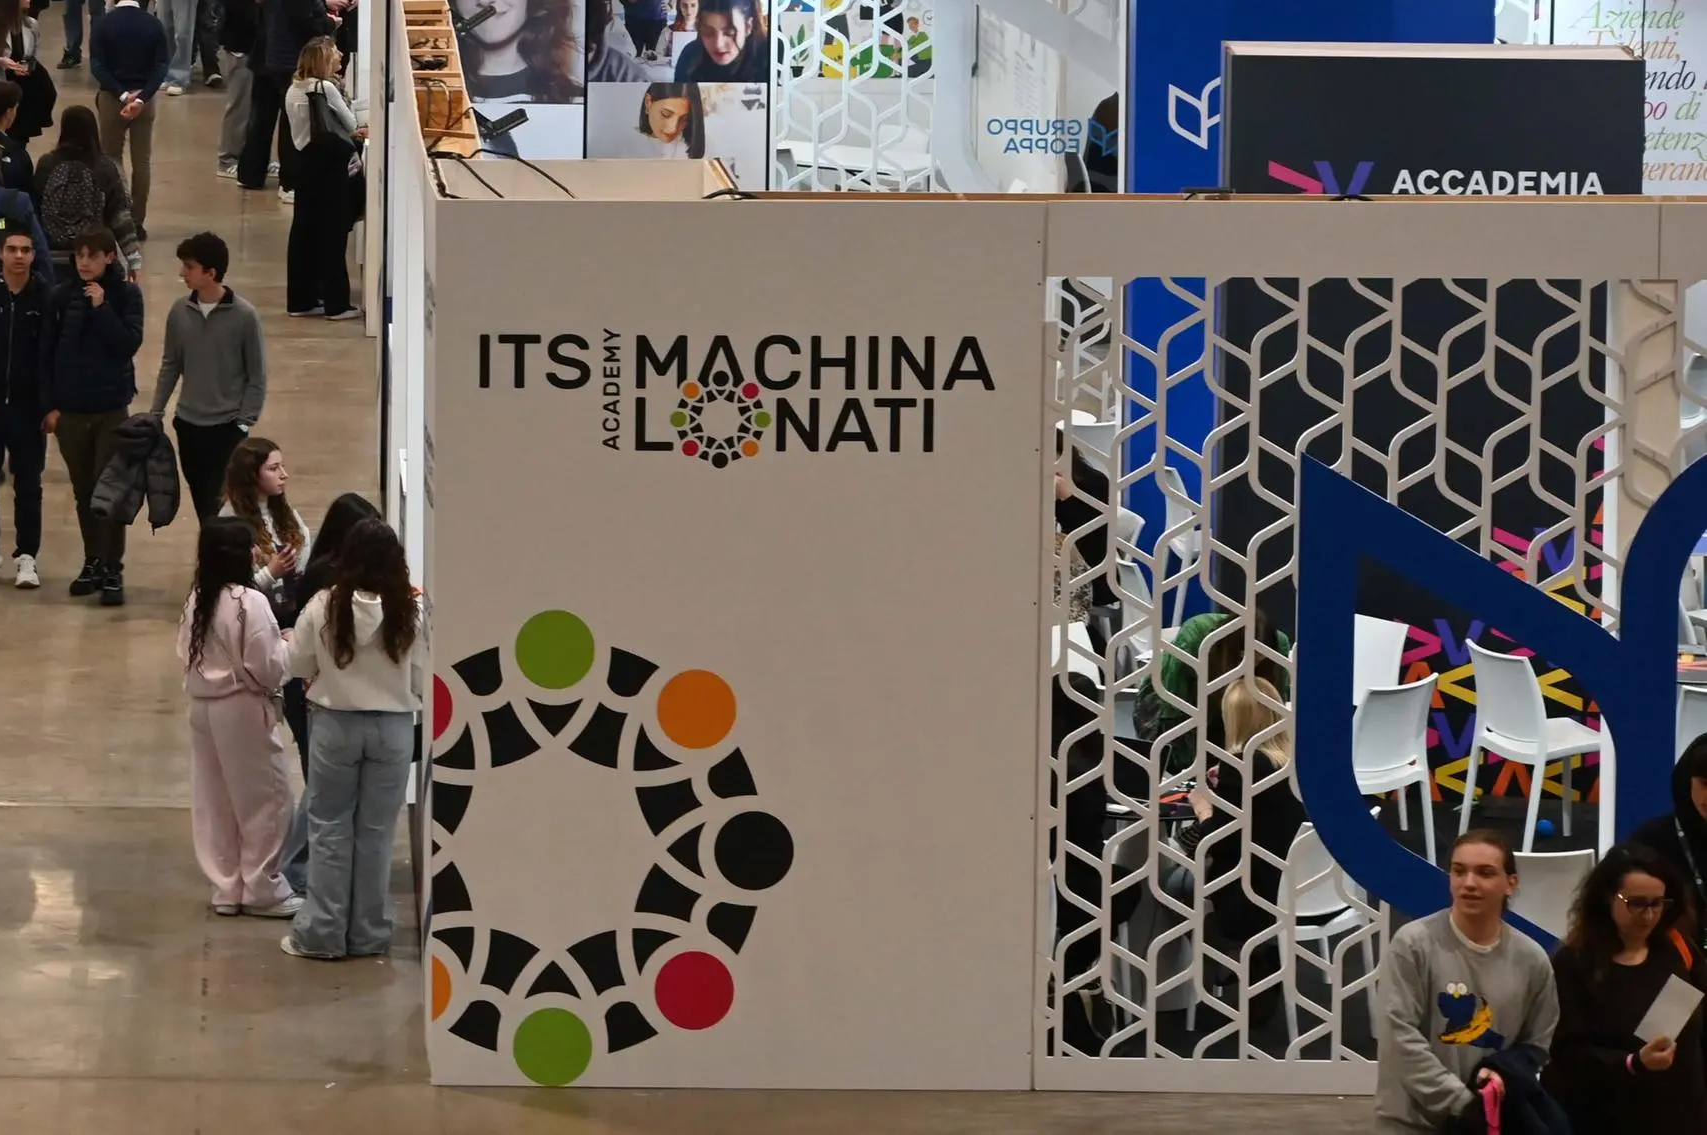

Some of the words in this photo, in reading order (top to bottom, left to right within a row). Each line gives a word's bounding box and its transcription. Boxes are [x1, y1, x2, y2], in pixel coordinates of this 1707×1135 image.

[1569, 0, 1686, 39] Aziende
[1675, 91, 1703, 120] di
[1392, 168, 1604, 196] ACCADEMIA
[479, 334, 592, 390] ITS
[635, 334, 996, 391] MACHINA
[602, 328, 622, 451] ACADEMY
